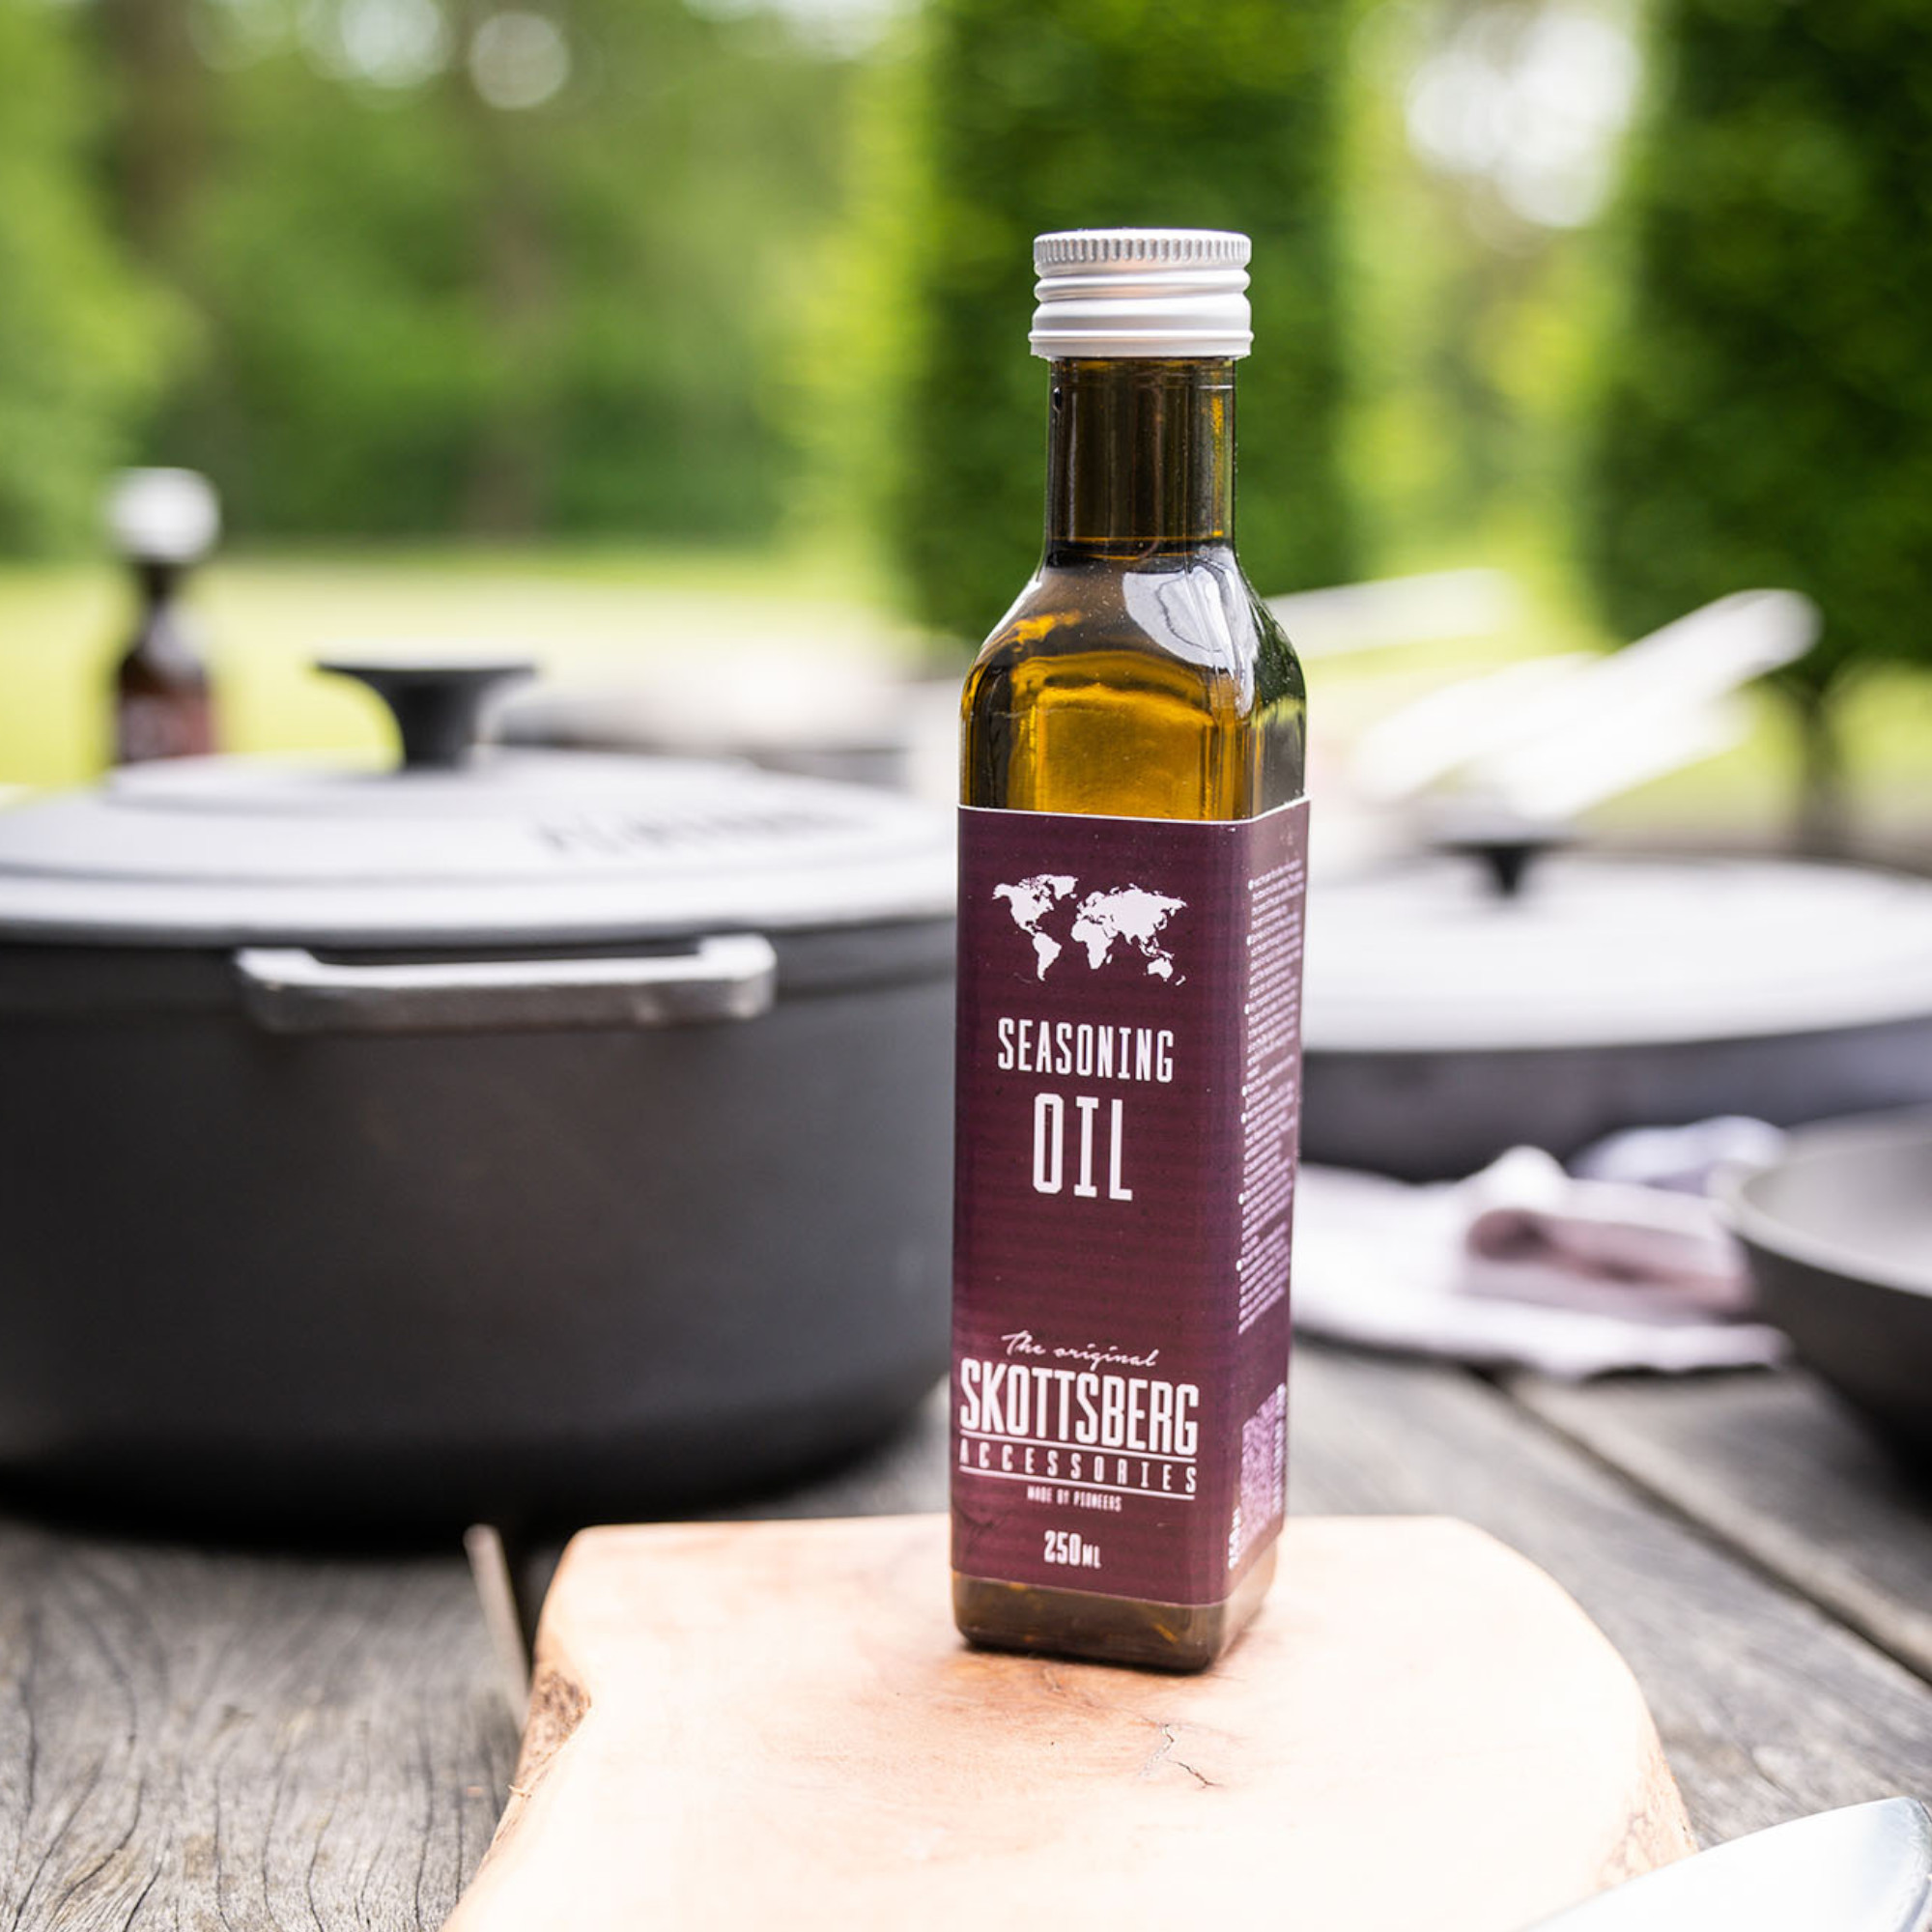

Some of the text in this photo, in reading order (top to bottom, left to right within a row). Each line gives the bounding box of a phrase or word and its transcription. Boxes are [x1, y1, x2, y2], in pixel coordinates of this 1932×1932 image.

[997, 1017, 1175, 1084] SEASONING
[1033, 1093, 1133, 1202] OIL
[1002, 1330, 1157, 1372] The original
[960, 1357, 1199, 1456] SKOTTSBERG
[959, 1437, 1198, 1492] ACCESSORIES
[1027, 1486, 1122, 1513] MADE BY PIONEERS
